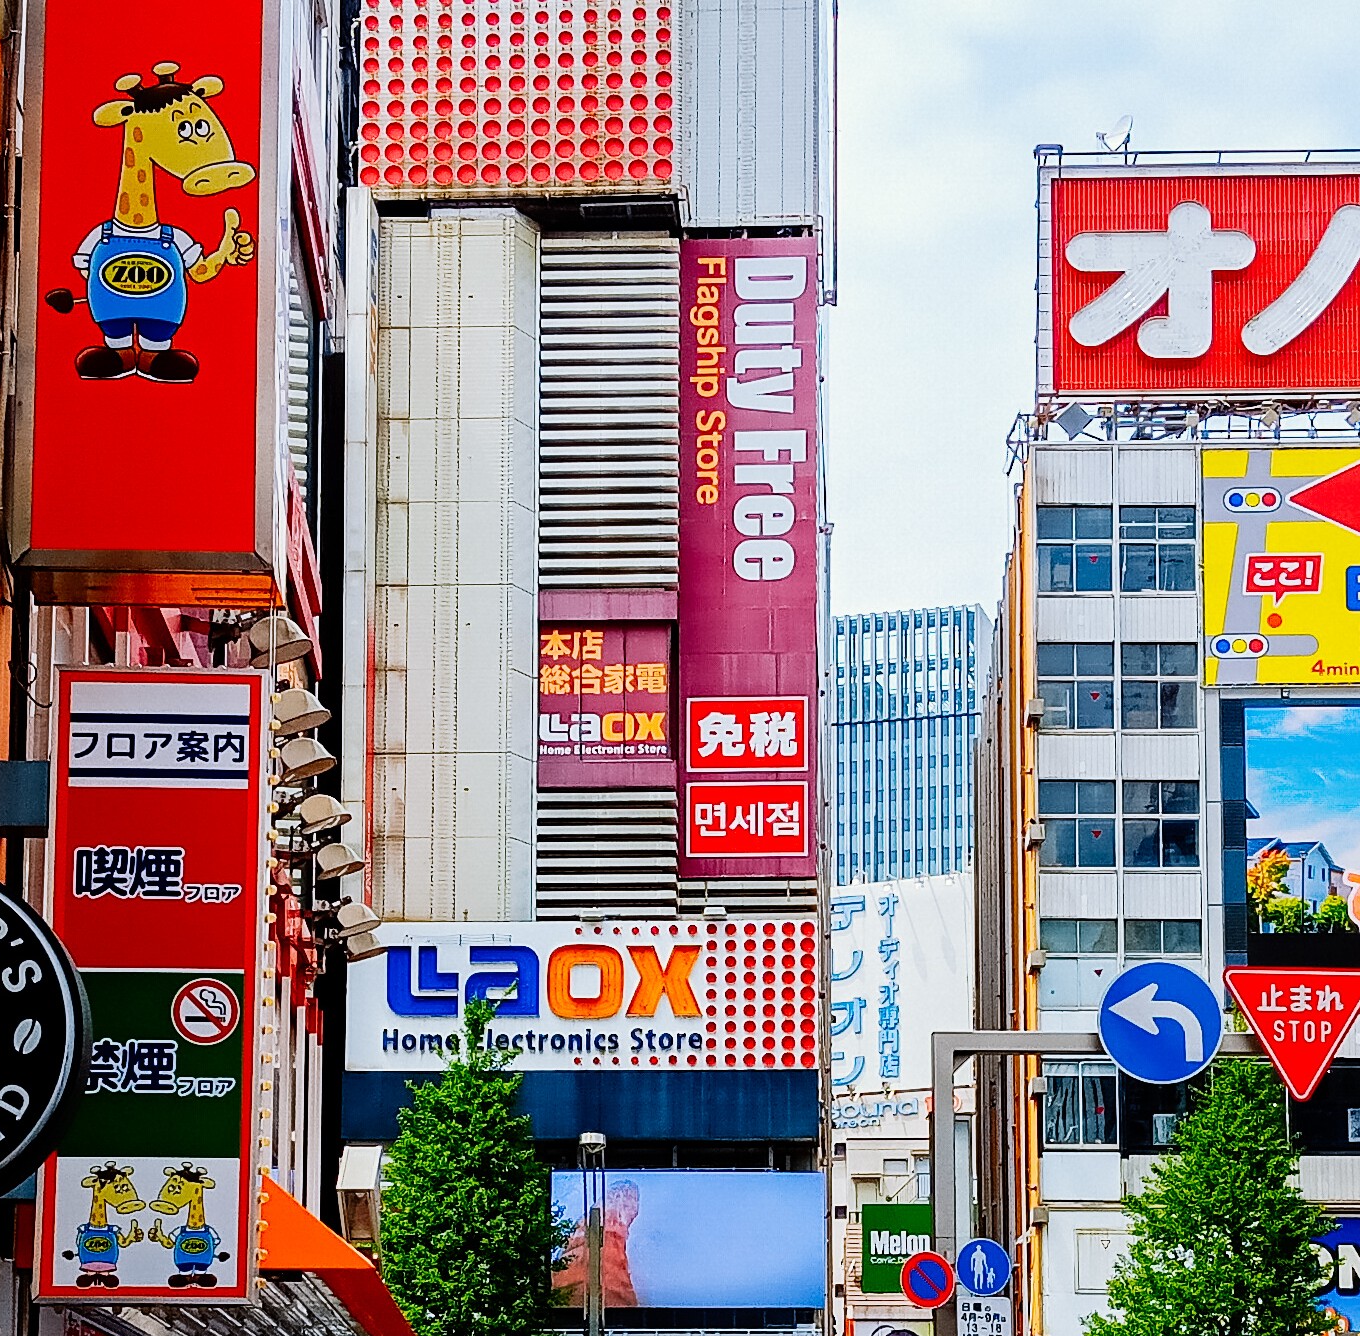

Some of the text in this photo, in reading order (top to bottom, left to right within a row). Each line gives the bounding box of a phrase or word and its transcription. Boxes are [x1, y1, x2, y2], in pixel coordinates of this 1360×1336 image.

[112, 265, 164, 284] ZOO
[690, 256, 726, 506] Flagship Store
[726, 257, 807, 581] Duty Free
[1252, 559, 1314, 591] ここ!
[540, 630, 603, 660] 本店
[539, 663, 667, 695] 総合家電
[72, 729, 246, 765] フロア案内
[539, 744, 667, 756] Home Electronics Store
[697, 711, 799, 759] 免税
[694, 800, 801, 839] 면세점
[877, 892, 901, 1079] オーディオ専門店
[1256, 984, 1343, 1014] 止まれ
[382, 1028, 460, 1054] Home
[631, 1027, 704, 1054] Store
[1273, 1018, 1334, 1044] STOP
